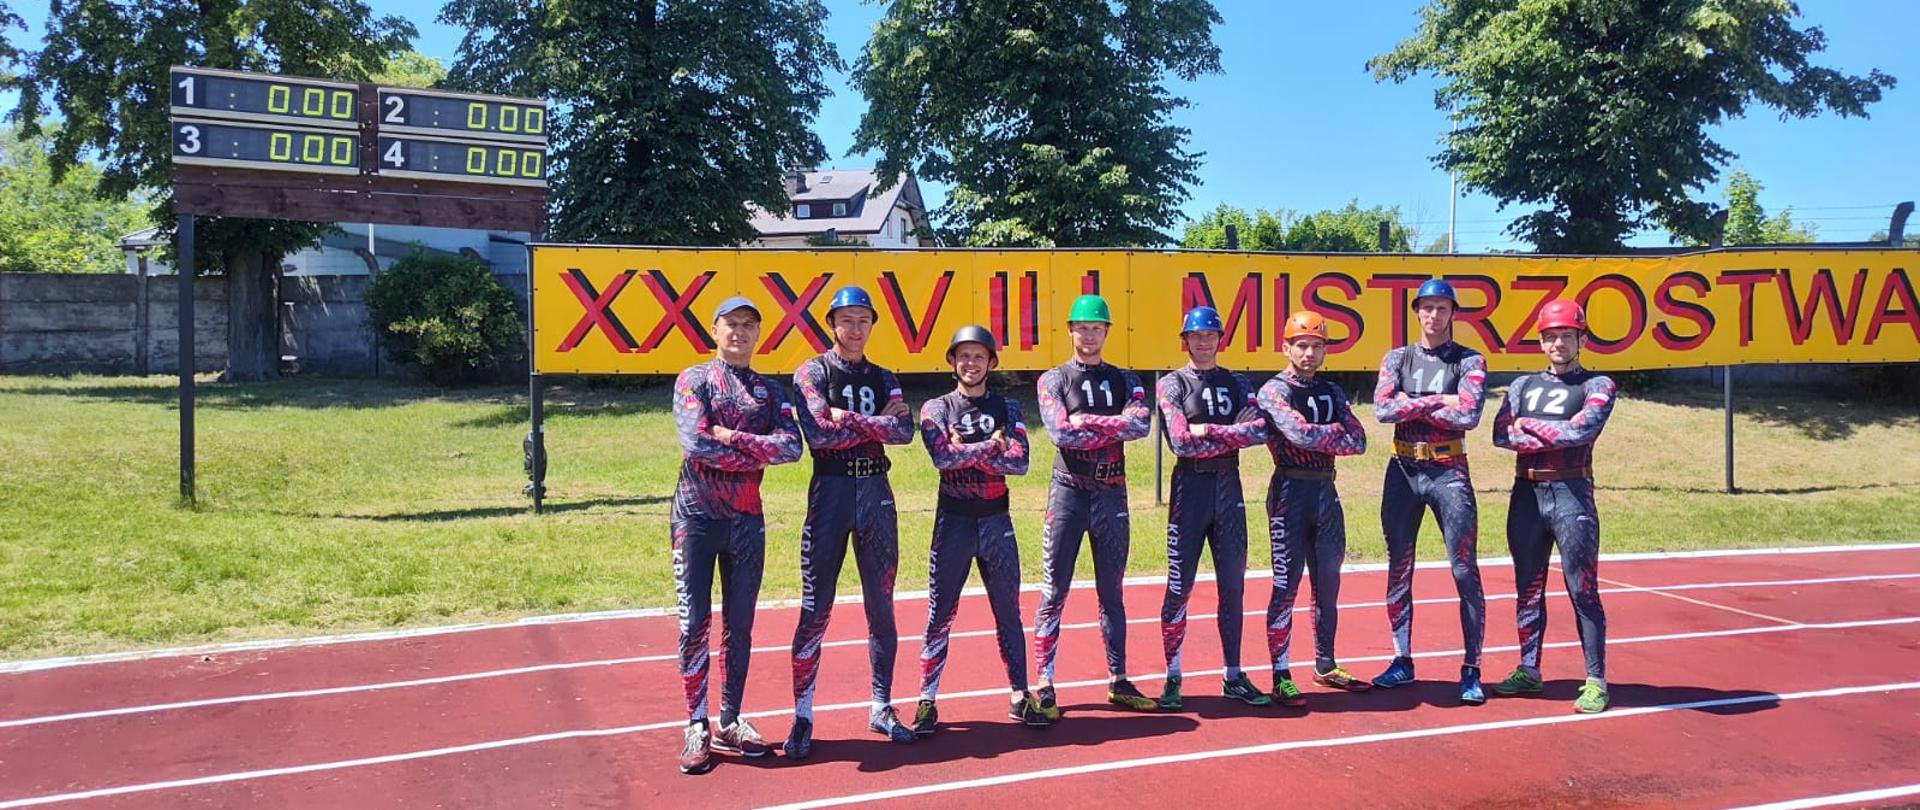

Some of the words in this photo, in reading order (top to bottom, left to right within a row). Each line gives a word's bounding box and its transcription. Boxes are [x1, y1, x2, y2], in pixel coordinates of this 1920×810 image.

[178, 77, 196, 105] 1
[384, 96, 405, 123] 2
[179, 125, 201, 154] 3
[383, 141, 405, 167] 4
[1081, 380, 1113, 407] 11
[1411, 368, 1446, 393] 14
[840, 384, 875, 416] 18
[1202, 387, 1234, 416] 15
[1306, 394, 1333, 422] 17
[1525, 386, 1570, 414] 12
